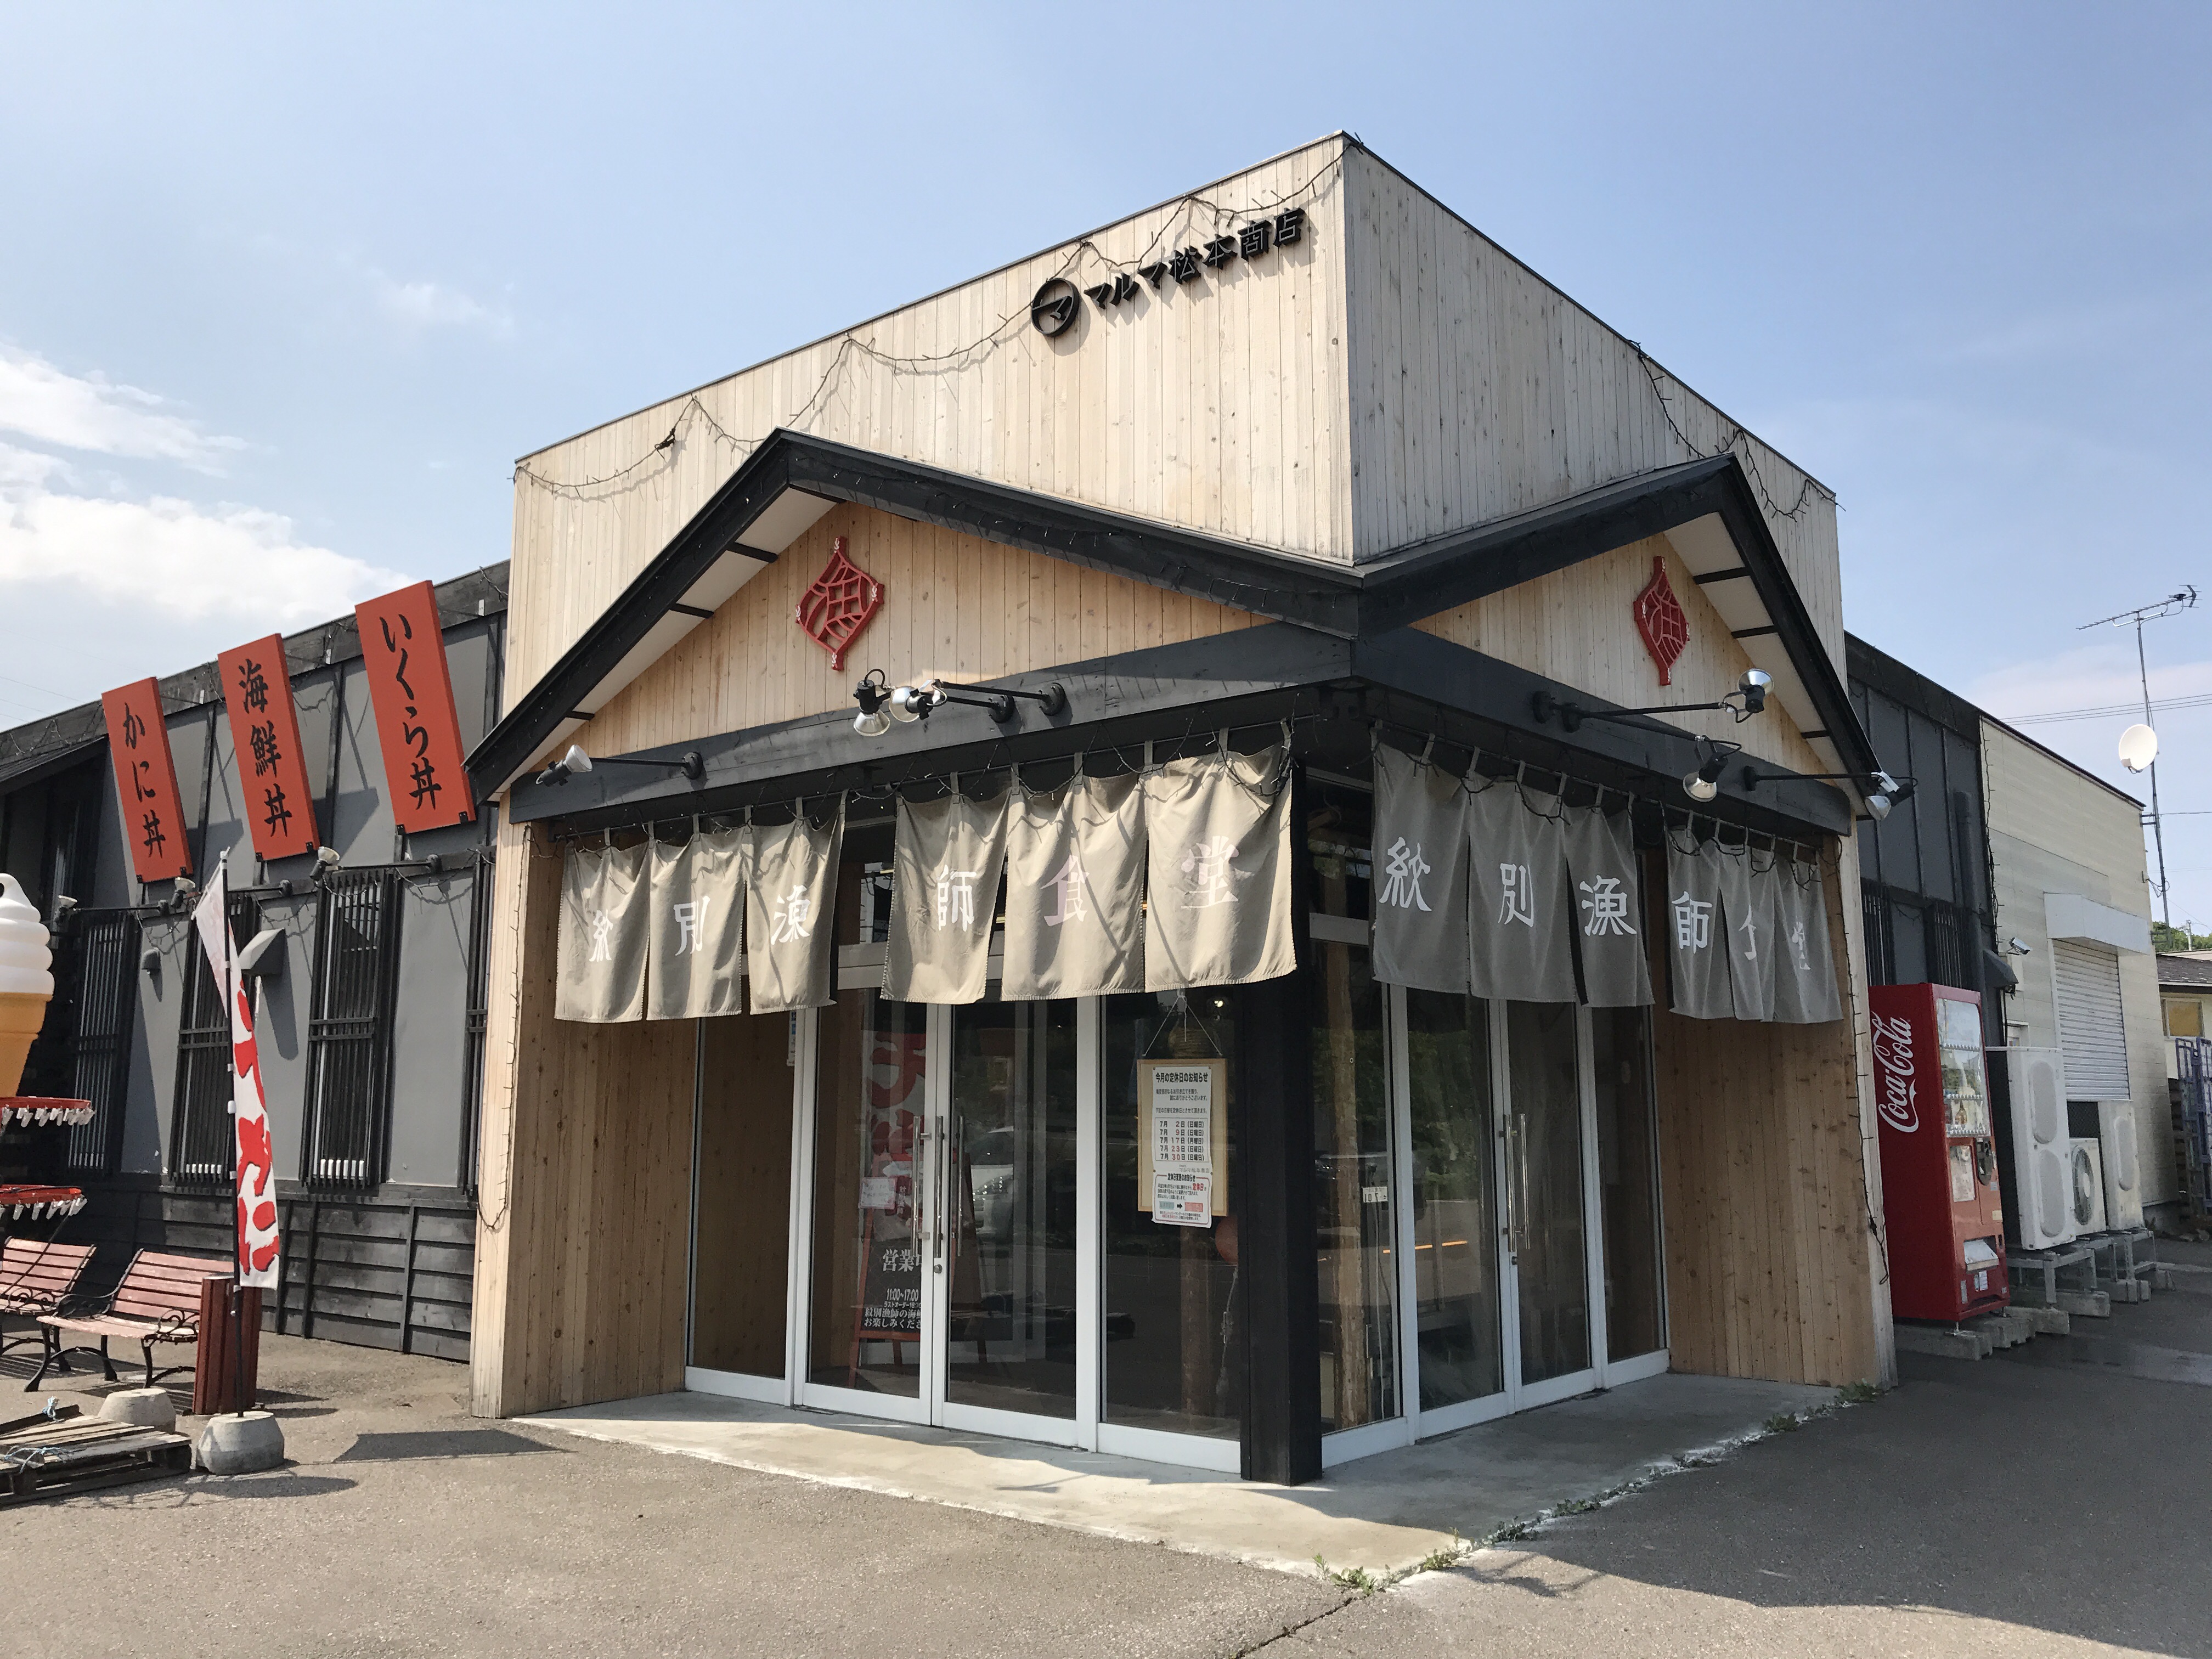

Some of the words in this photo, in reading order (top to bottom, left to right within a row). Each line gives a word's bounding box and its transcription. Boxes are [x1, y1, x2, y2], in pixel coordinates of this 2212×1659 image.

[1084, 207, 1305, 309] マルマ松本商店
[123, 702, 166, 859] かに丼
[238, 658, 292, 837] 海鮮丼
[379, 613, 442, 810] いくら丼
[1155, 1072, 1208, 1083] 今月の定休日のお知らせ
[1871, 1011, 1919, 1133] Coca-Cola
